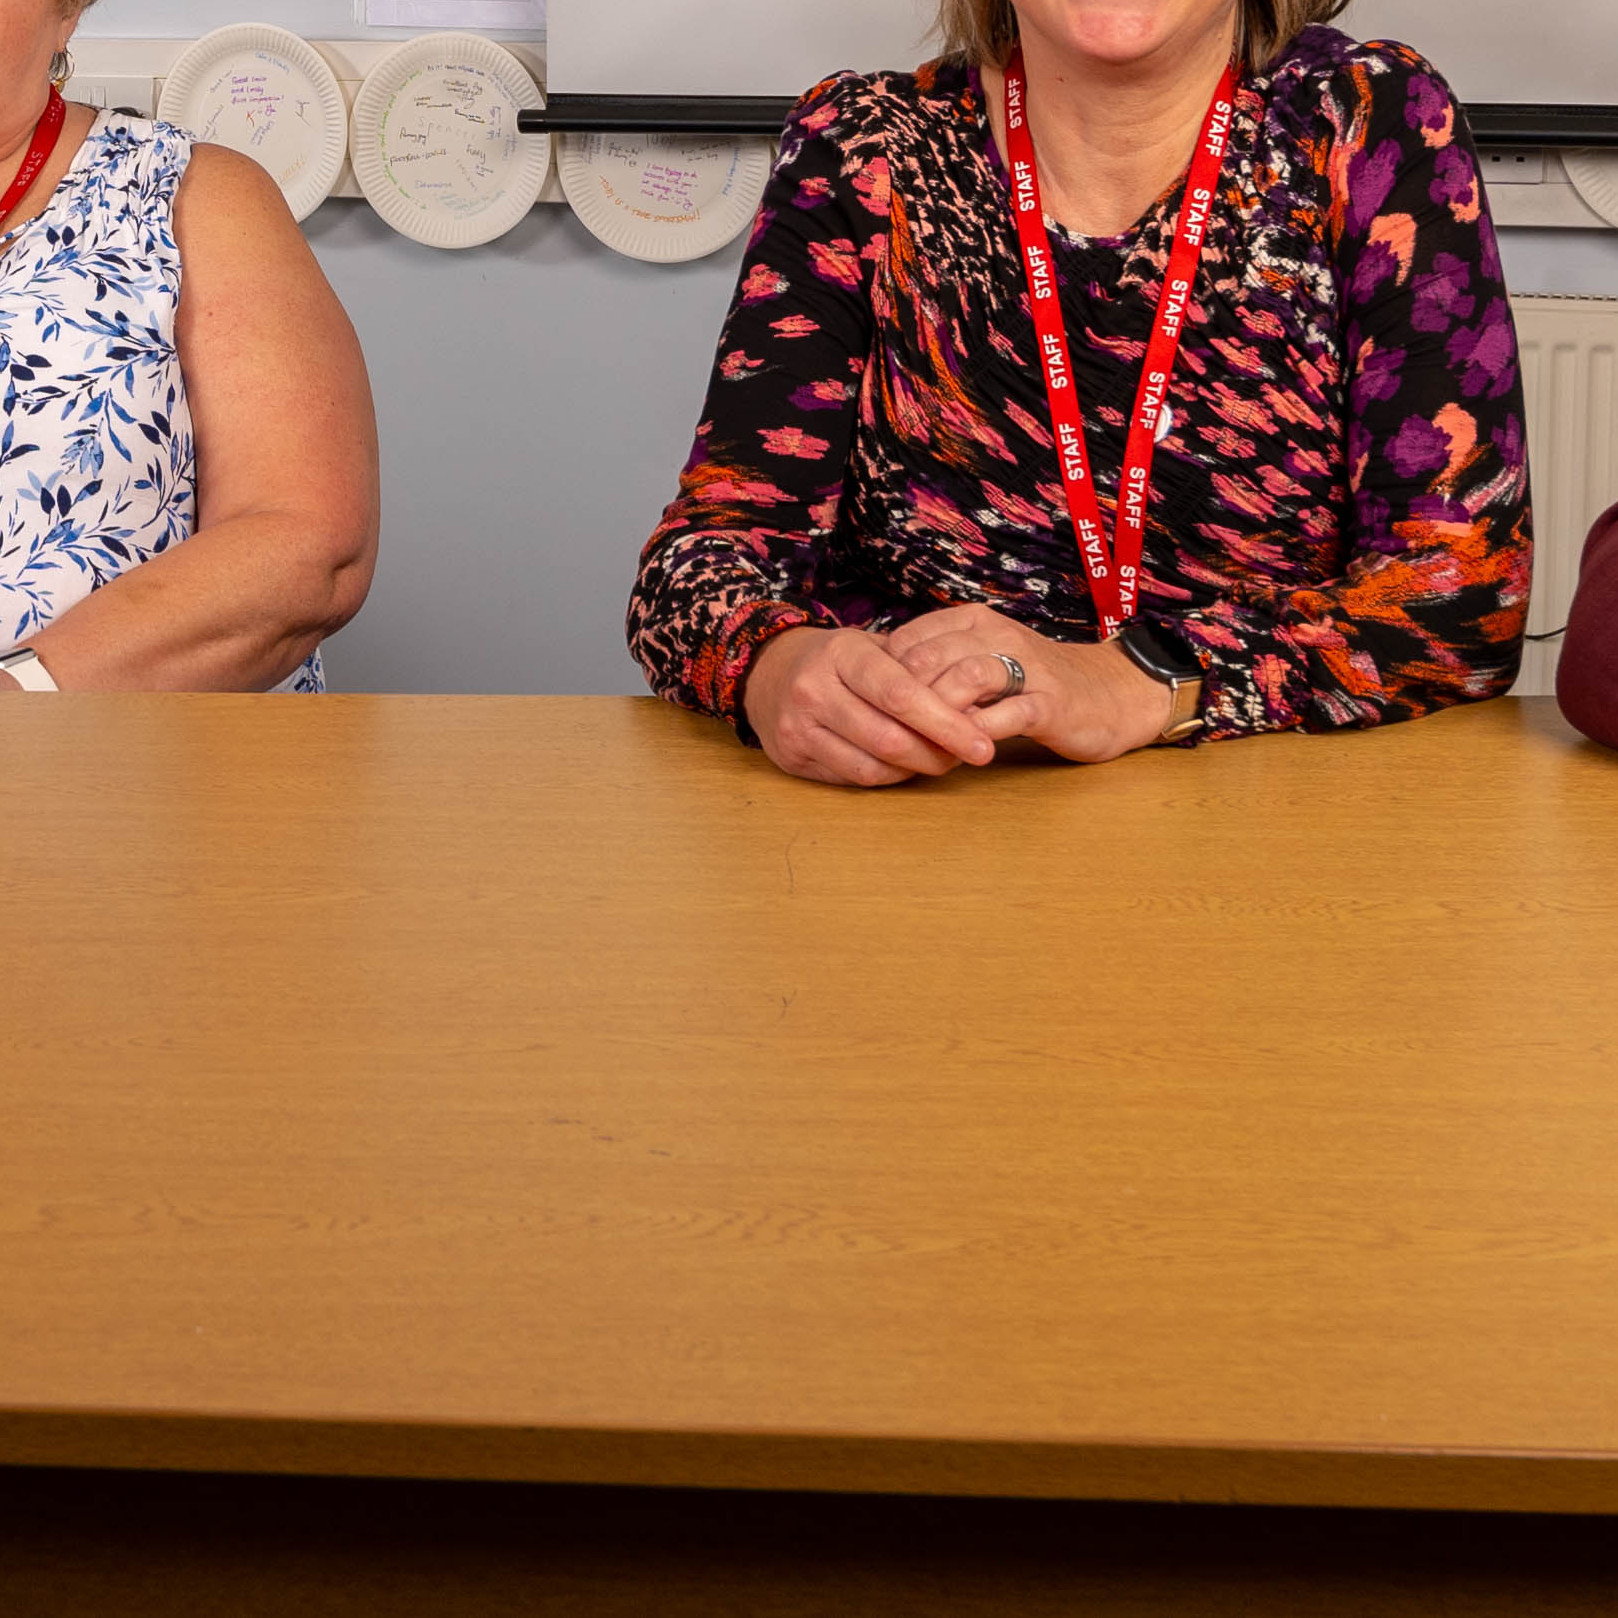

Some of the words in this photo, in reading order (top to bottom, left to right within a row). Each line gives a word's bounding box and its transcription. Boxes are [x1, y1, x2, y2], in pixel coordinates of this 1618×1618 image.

[1008, 78, 1021, 130] STAFF
[1205, 99, 1232, 158] STAFF
[1014, 160, 1035, 212] STAFF
[1183, 187, 1211, 247] STAFF
[1027, 245, 1052, 300] STAFF
[1161, 279, 1189, 338] STAFF
[1043, 333, 1068, 389] STAFF
[1139, 371, 1166, 431] STAFF
[1059, 423, 1085, 481] STAFF
[1124, 466, 1147, 530] STAFF
[1079, 519, 1108, 579] STAFF
